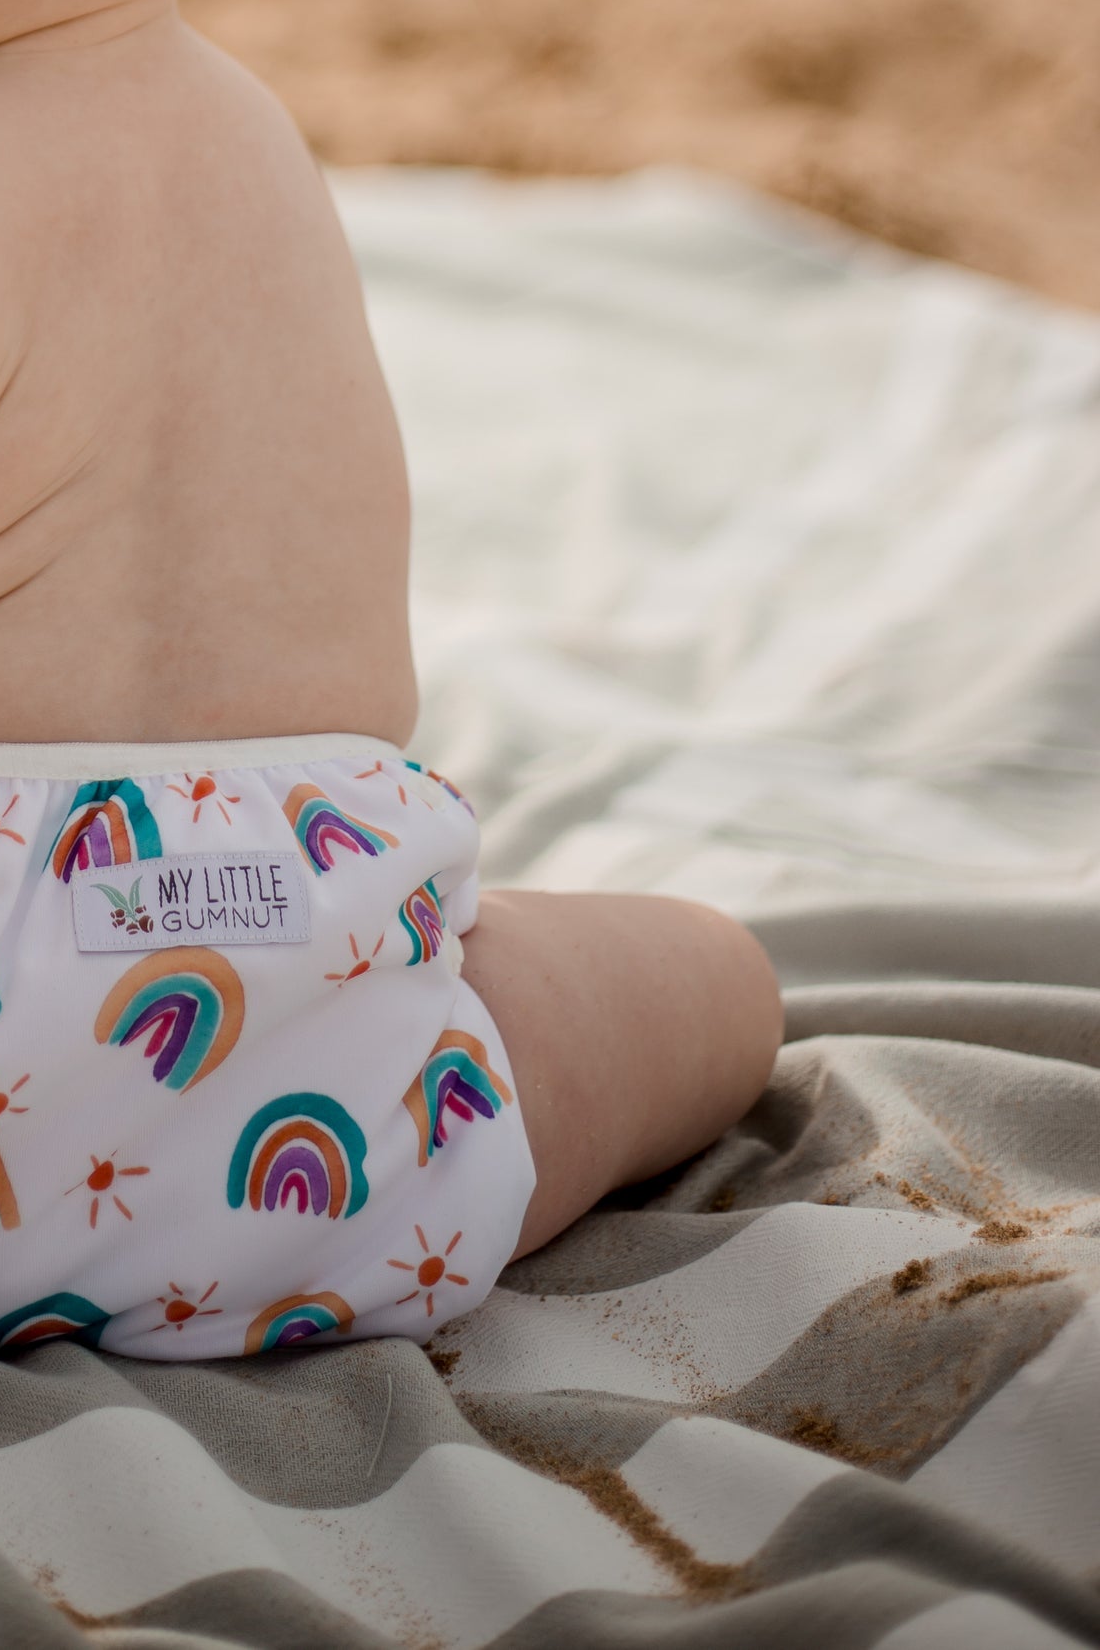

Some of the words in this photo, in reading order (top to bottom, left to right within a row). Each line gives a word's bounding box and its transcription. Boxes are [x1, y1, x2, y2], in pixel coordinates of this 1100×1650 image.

[158, 868, 192, 908] MY
[204, 865, 287, 903] LITTLE
[161, 905, 288, 932] GUMNUT
